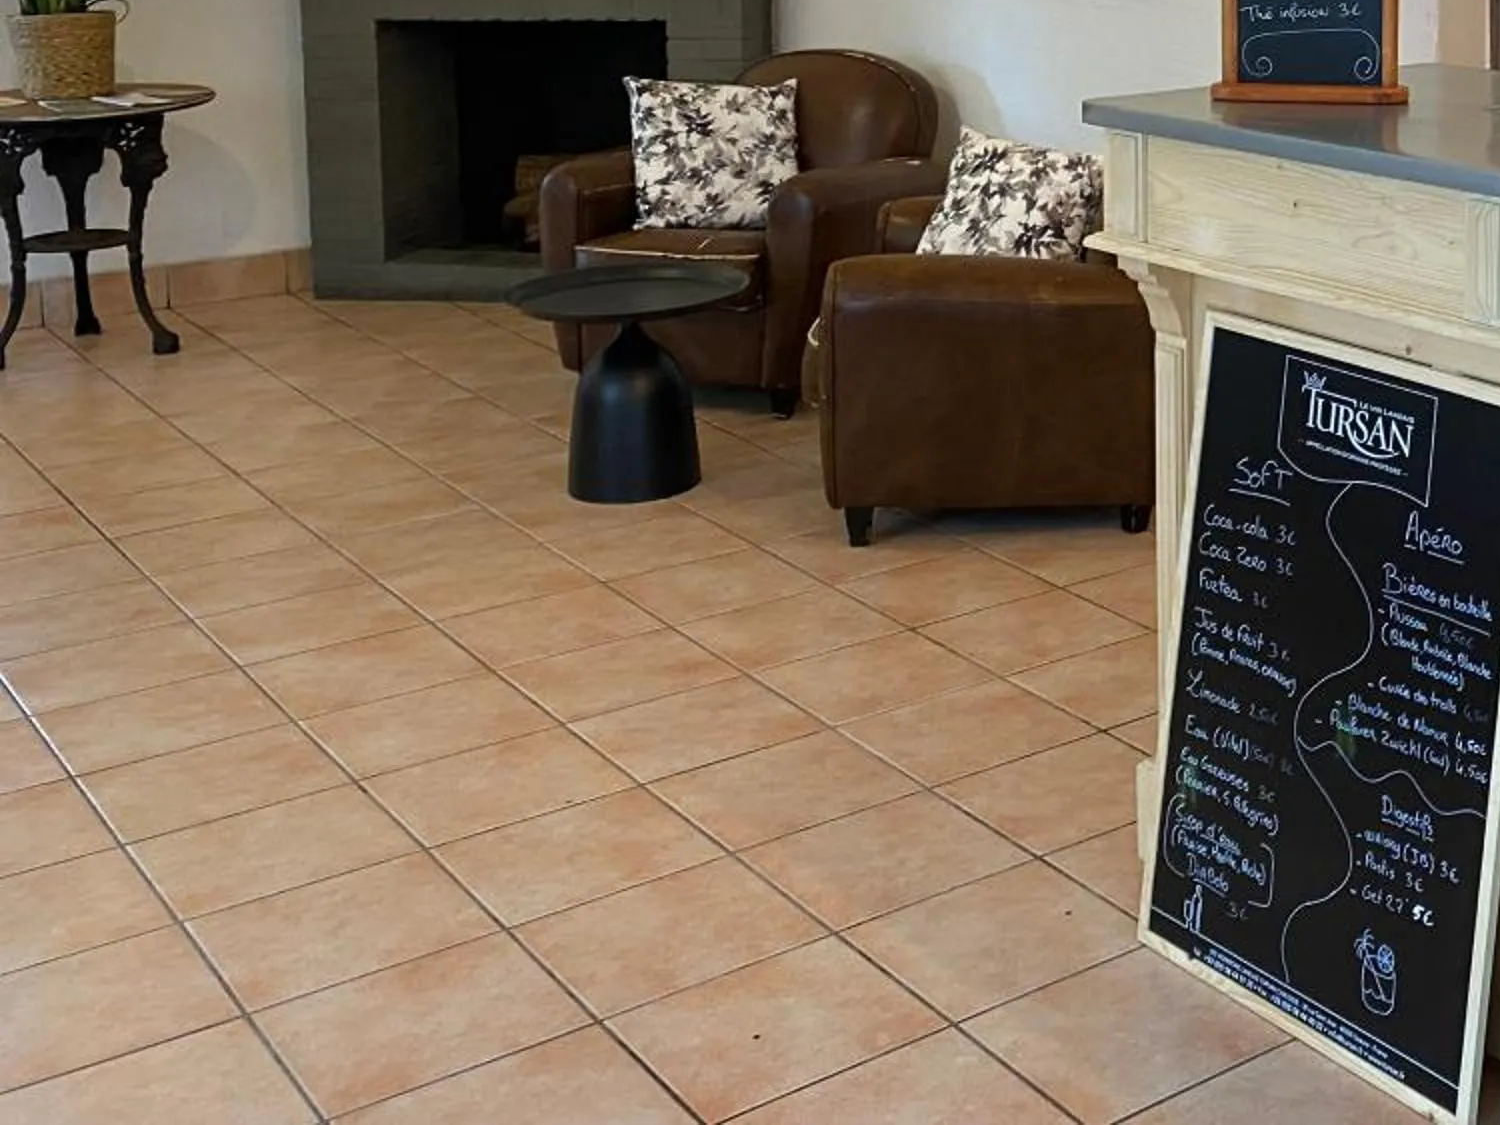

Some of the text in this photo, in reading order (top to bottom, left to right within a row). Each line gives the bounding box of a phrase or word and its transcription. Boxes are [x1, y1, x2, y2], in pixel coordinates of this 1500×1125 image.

[1302, 385, 1415, 458] TURSAN
[1405, 872, 1425, 893] 3€
[1412, 904, 1435, 927] 5€
